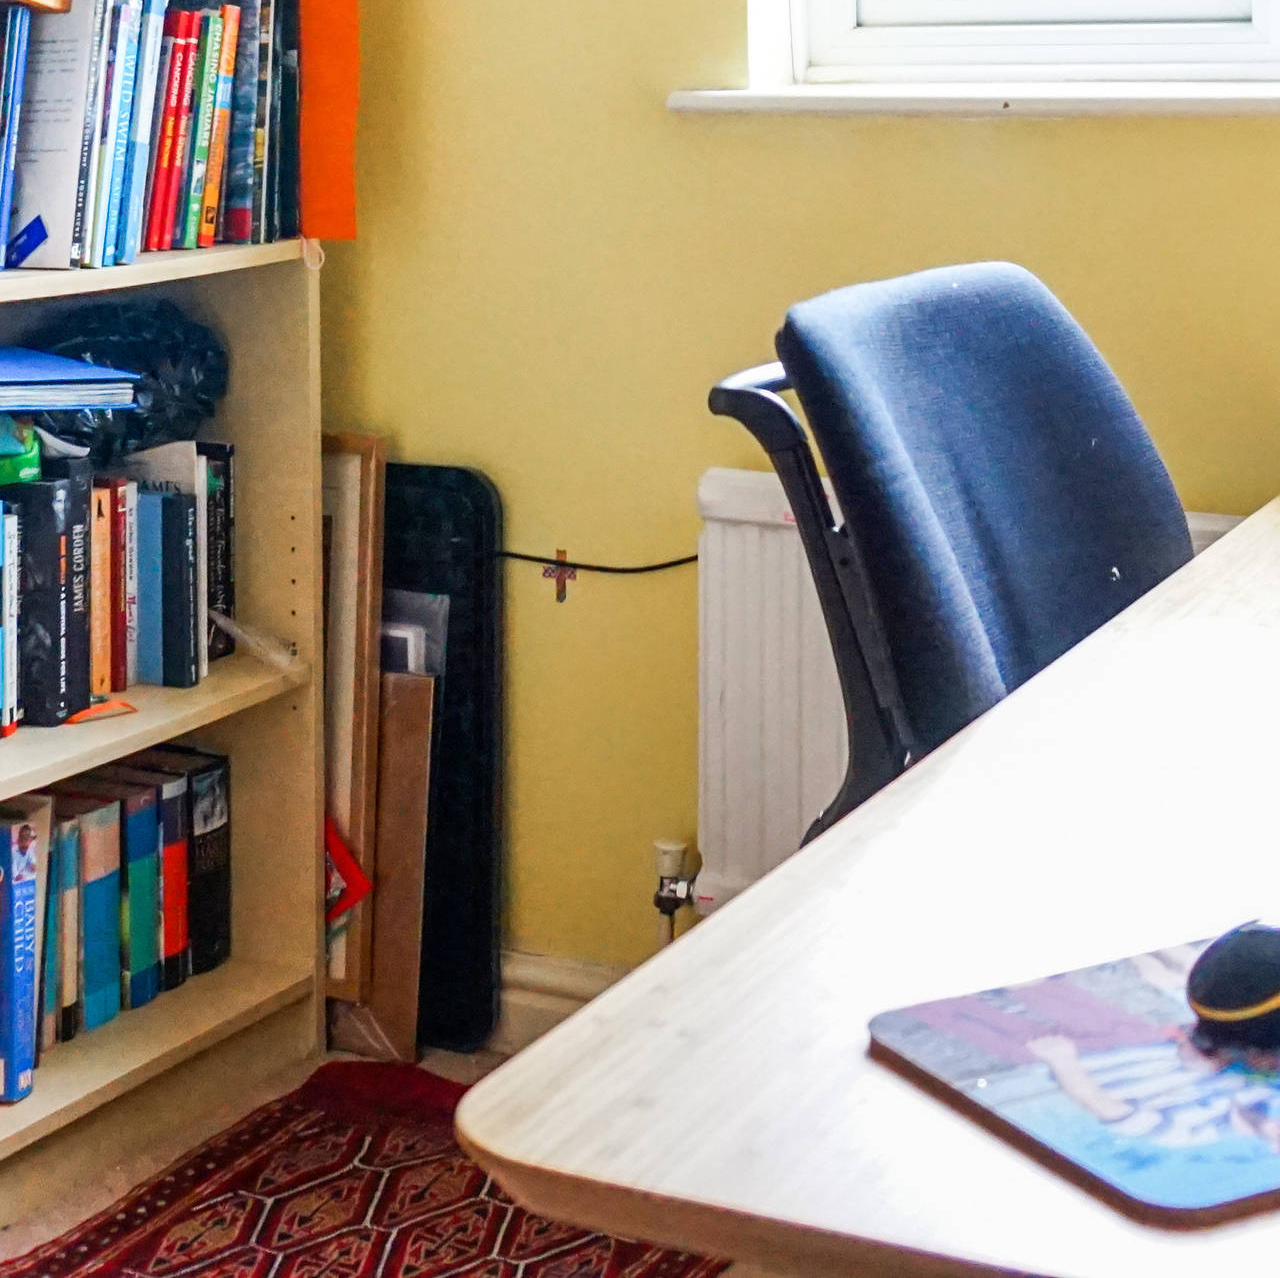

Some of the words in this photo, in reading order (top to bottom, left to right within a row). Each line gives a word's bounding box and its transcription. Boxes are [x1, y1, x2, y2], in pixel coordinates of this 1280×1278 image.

[120, 53, 137, 103] WILD
[170, 52, 183, 108] CANOEING
[207, 22, 223, 83] CHASING
[114, 110, 131, 163] SWIM
[201, 86, 215, 148] JAGUARS
[73, 524, 84, 571] CORDEN
[73, 573, 84, 613] JAMES
[14, 898, 24, 974] CHILD
[24, 897, 35, 956] BABY
